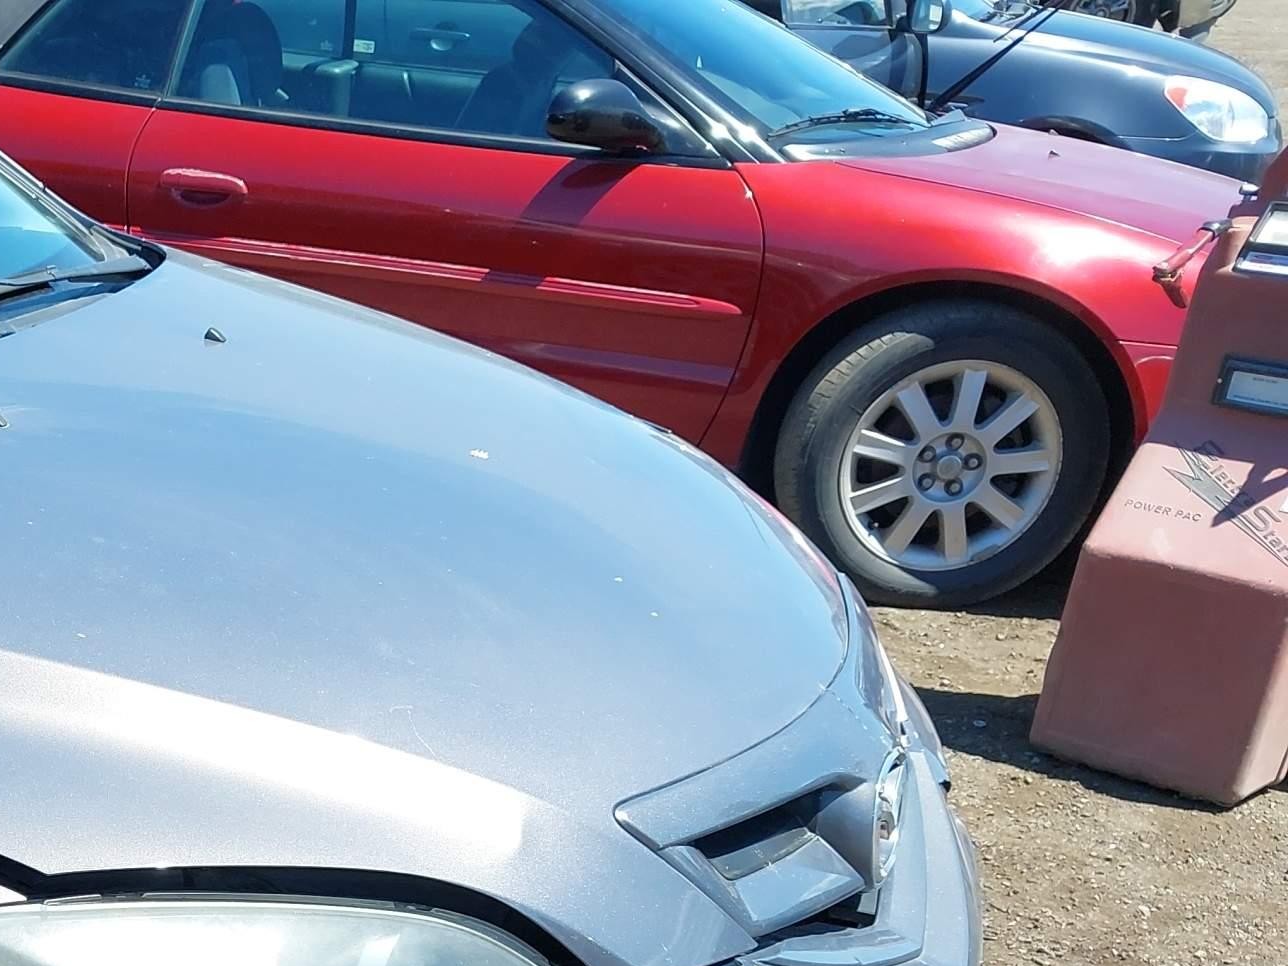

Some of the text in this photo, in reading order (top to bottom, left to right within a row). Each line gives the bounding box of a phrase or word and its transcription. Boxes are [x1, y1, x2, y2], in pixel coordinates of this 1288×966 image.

[1123, 498, 1202, 522] POWER PAC
[1252, 505, 1288, 562] Star
